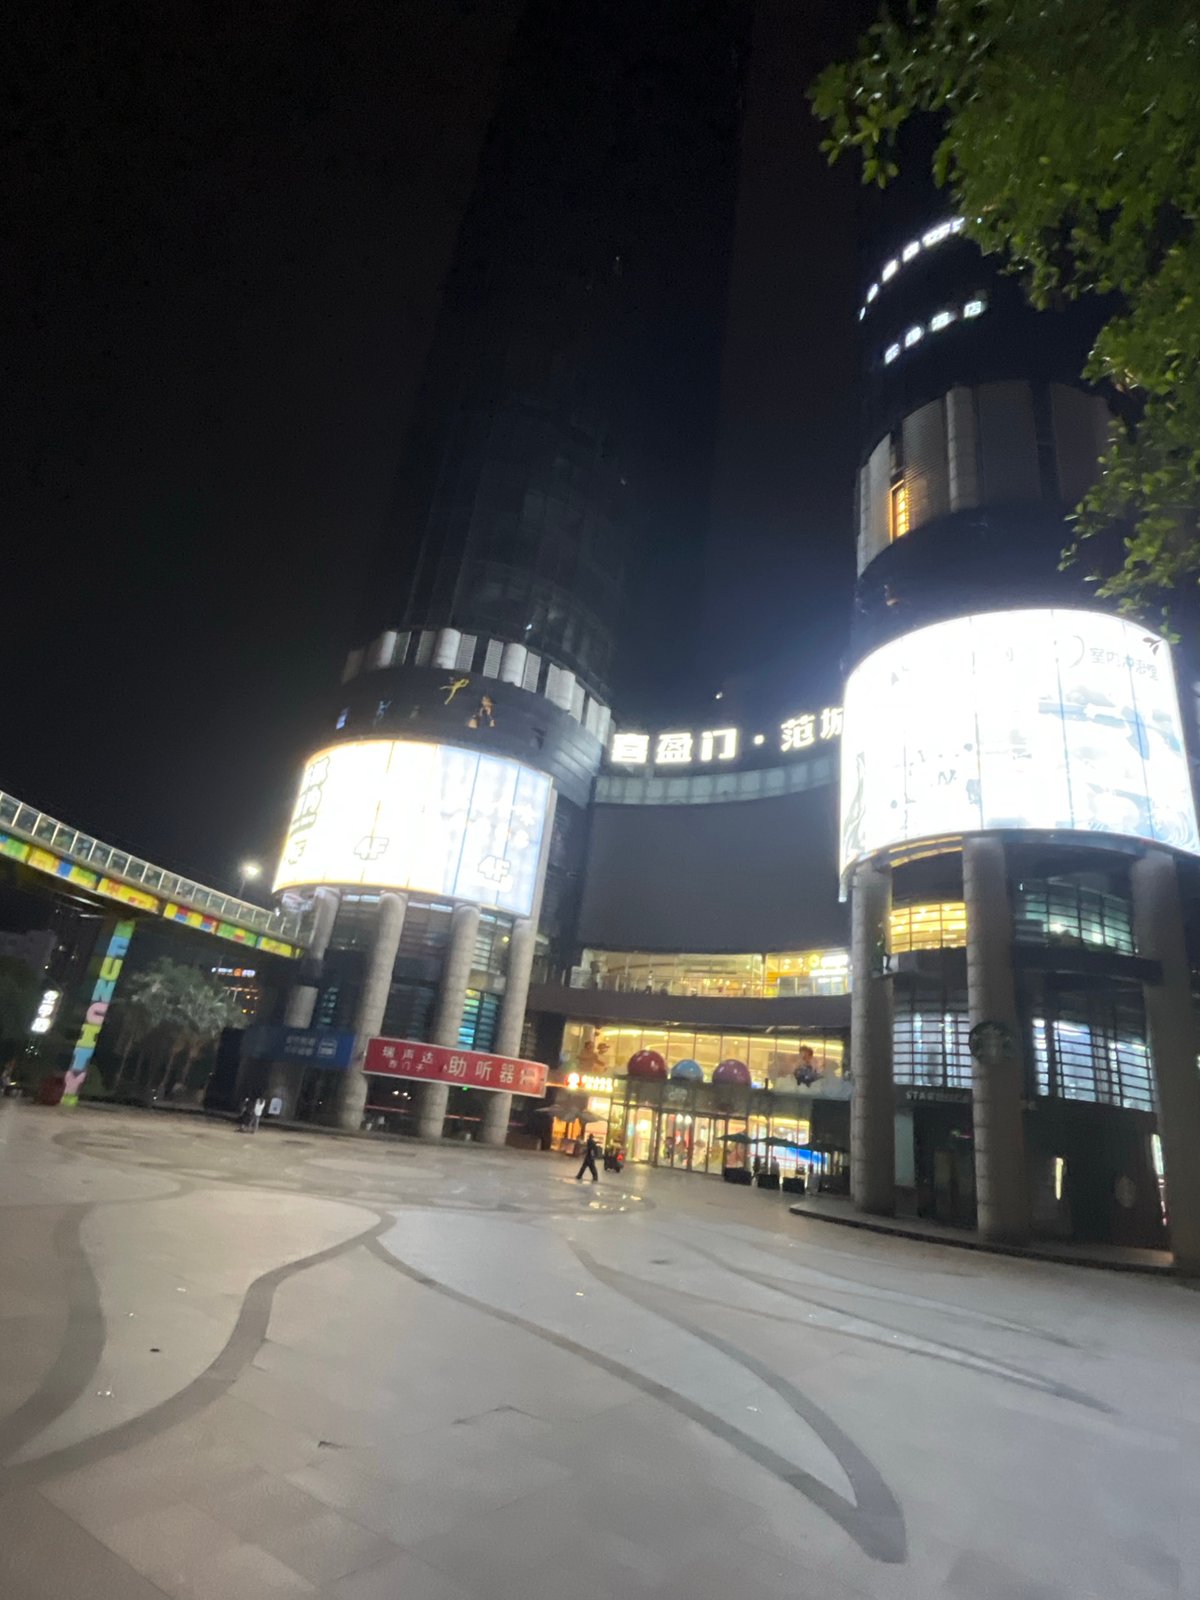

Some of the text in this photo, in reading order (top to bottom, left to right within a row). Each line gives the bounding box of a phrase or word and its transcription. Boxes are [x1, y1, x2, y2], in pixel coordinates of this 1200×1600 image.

[477, 854, 512, 883] 4F
[447, 1055, 515, 1084] 助听器
